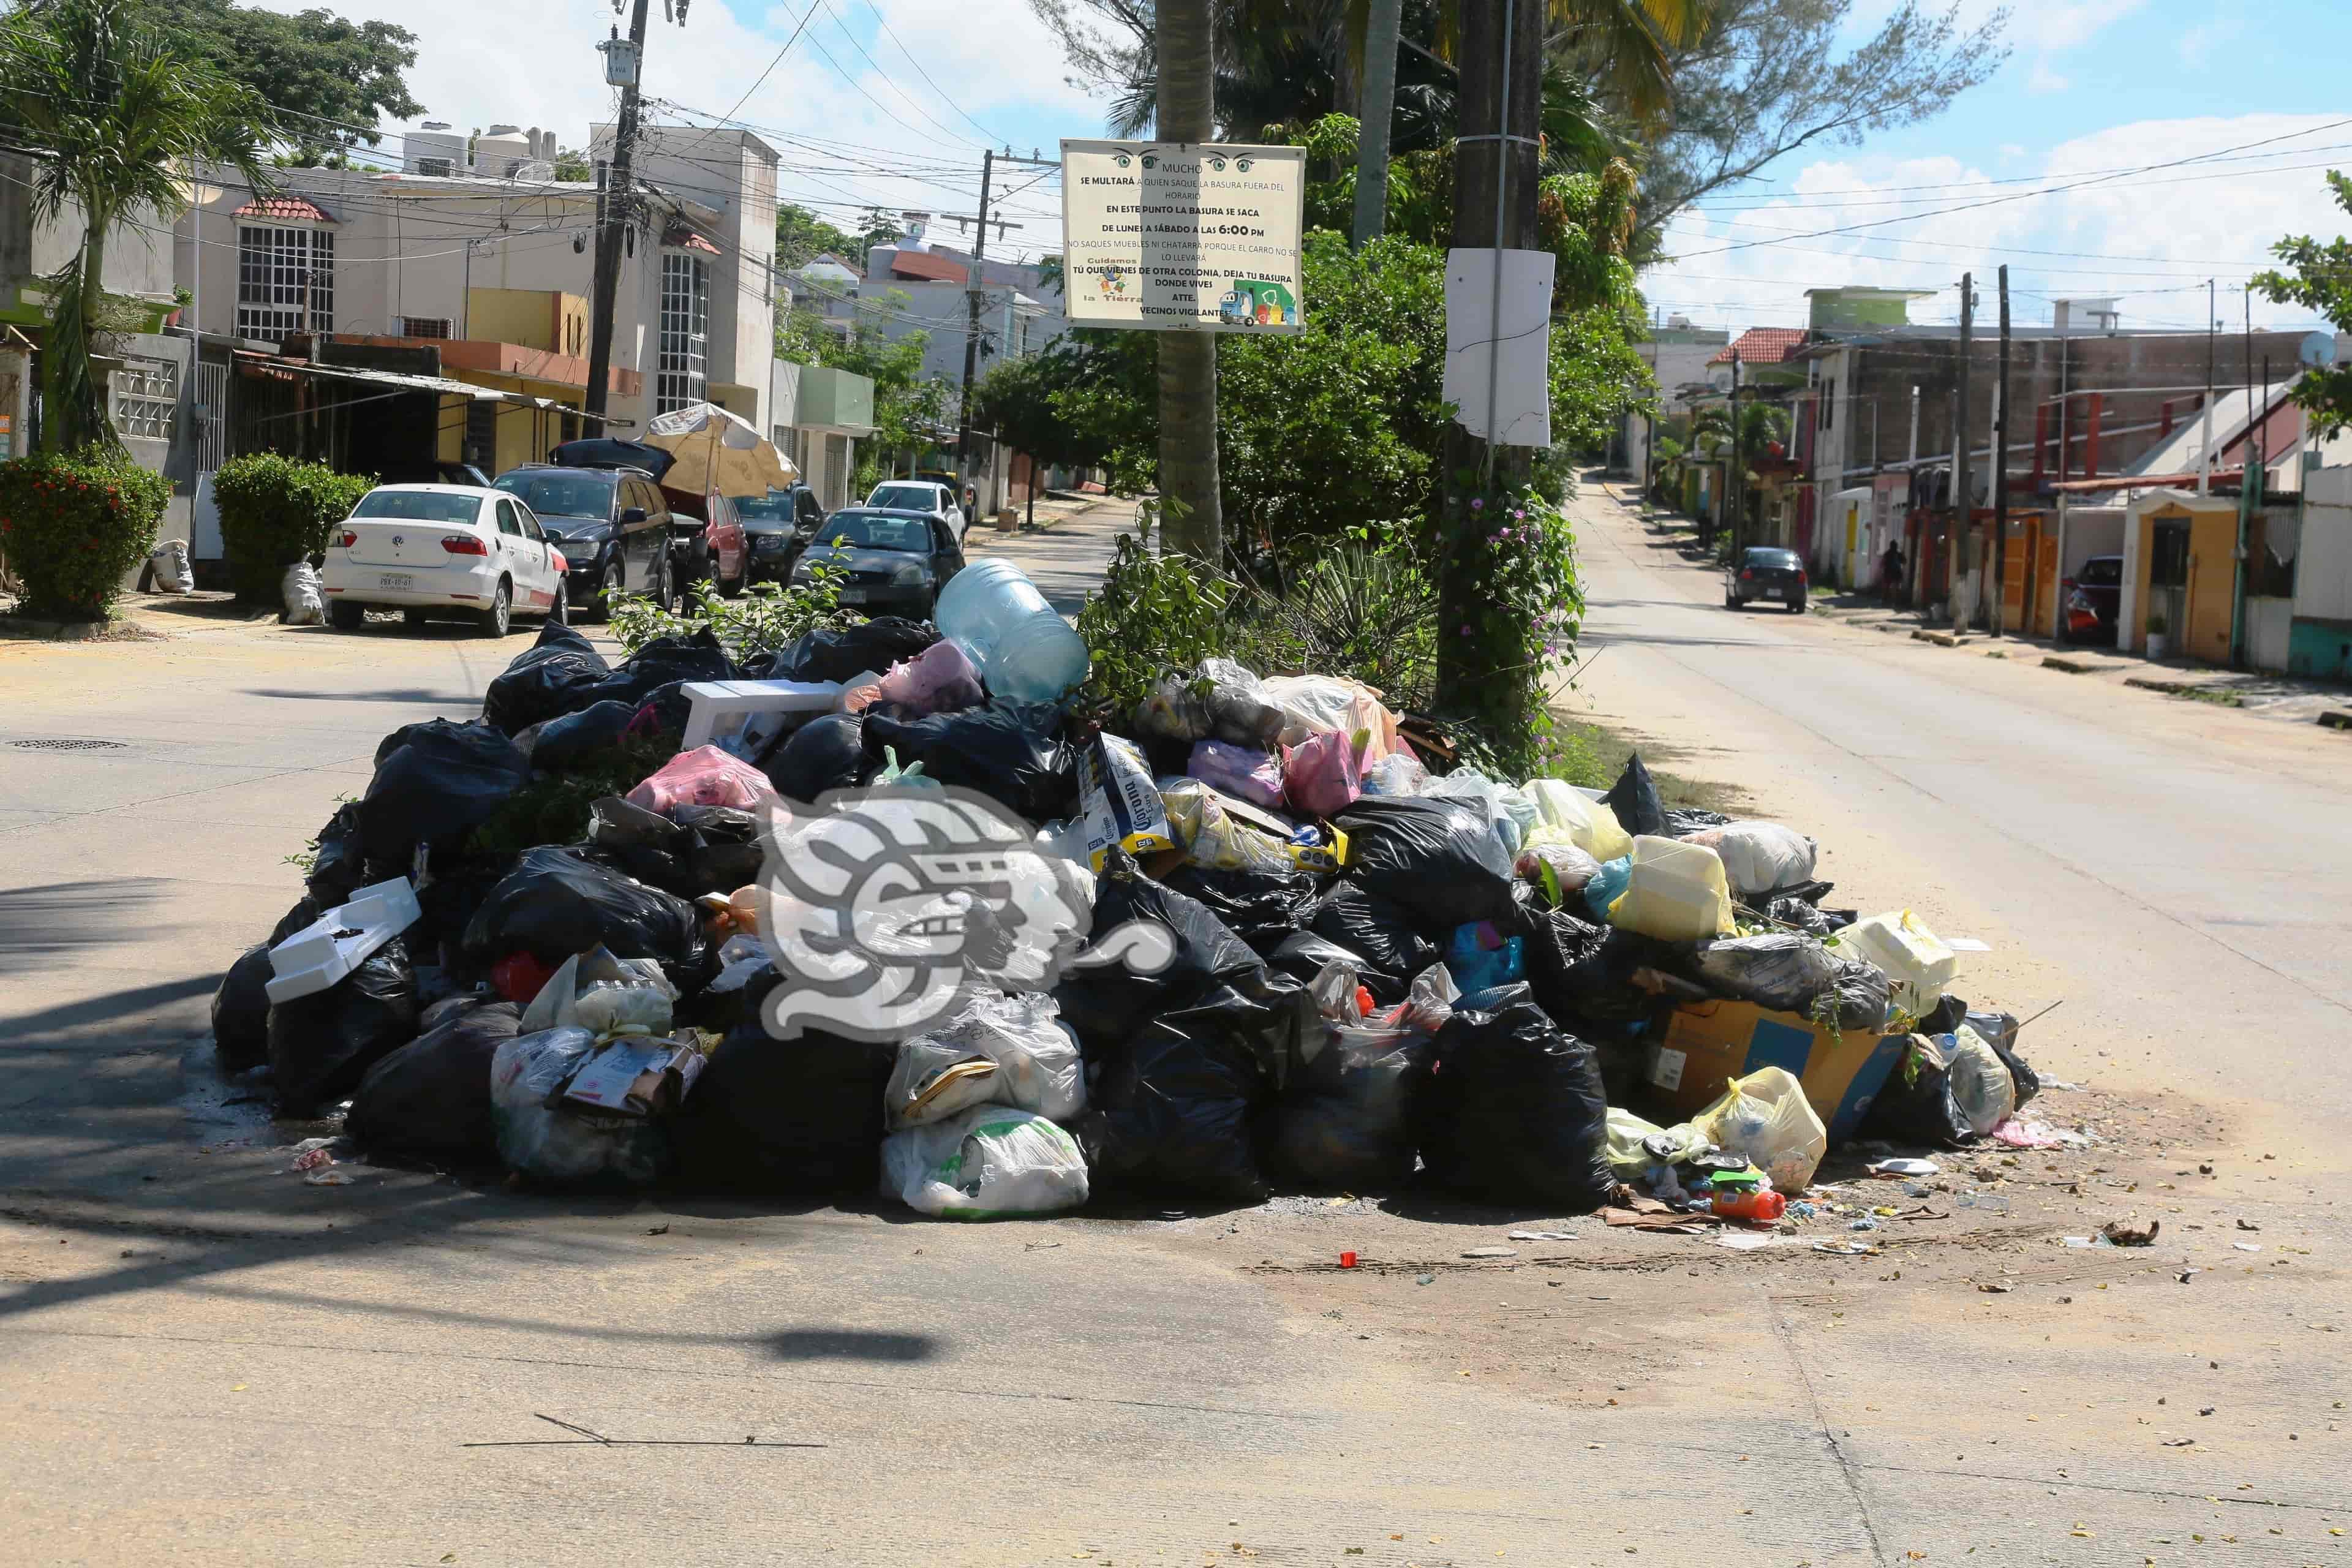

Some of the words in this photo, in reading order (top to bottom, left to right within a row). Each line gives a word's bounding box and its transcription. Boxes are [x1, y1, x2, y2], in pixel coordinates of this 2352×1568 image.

[1163, 164, 1202, 174] MUCHO
[1092, 176, 1134, 184] MULTARÁ
[1166, 192, 1200, 200] HORARIO
[1237, 208, 1259, 217] SACA
[1155, 223, 1190, 233] SÁBADO
[1219, 225, 1248, 235] 6:00
[1205, 243, 1236, 251] PORQUE
[1248, 245, 1273, 254] CARRO
[1276, 247, 1286, 256] NO
[1073, 265, 1084, 274] TÚ
[1087, 266, 1104, 275] QUE
[1178, 268, 1221, 277] COLONIA,
[1224, 270, 1244, 279] DEJA
[1246, 271, 1257, 280] TU
[1259, 273, 1292, 283] BASURA
[1189, 280, 1213, 288] VIVES
[1140, 306, 1176, 315] VECINOS
[1125, 780, 1152, 831] Corona
